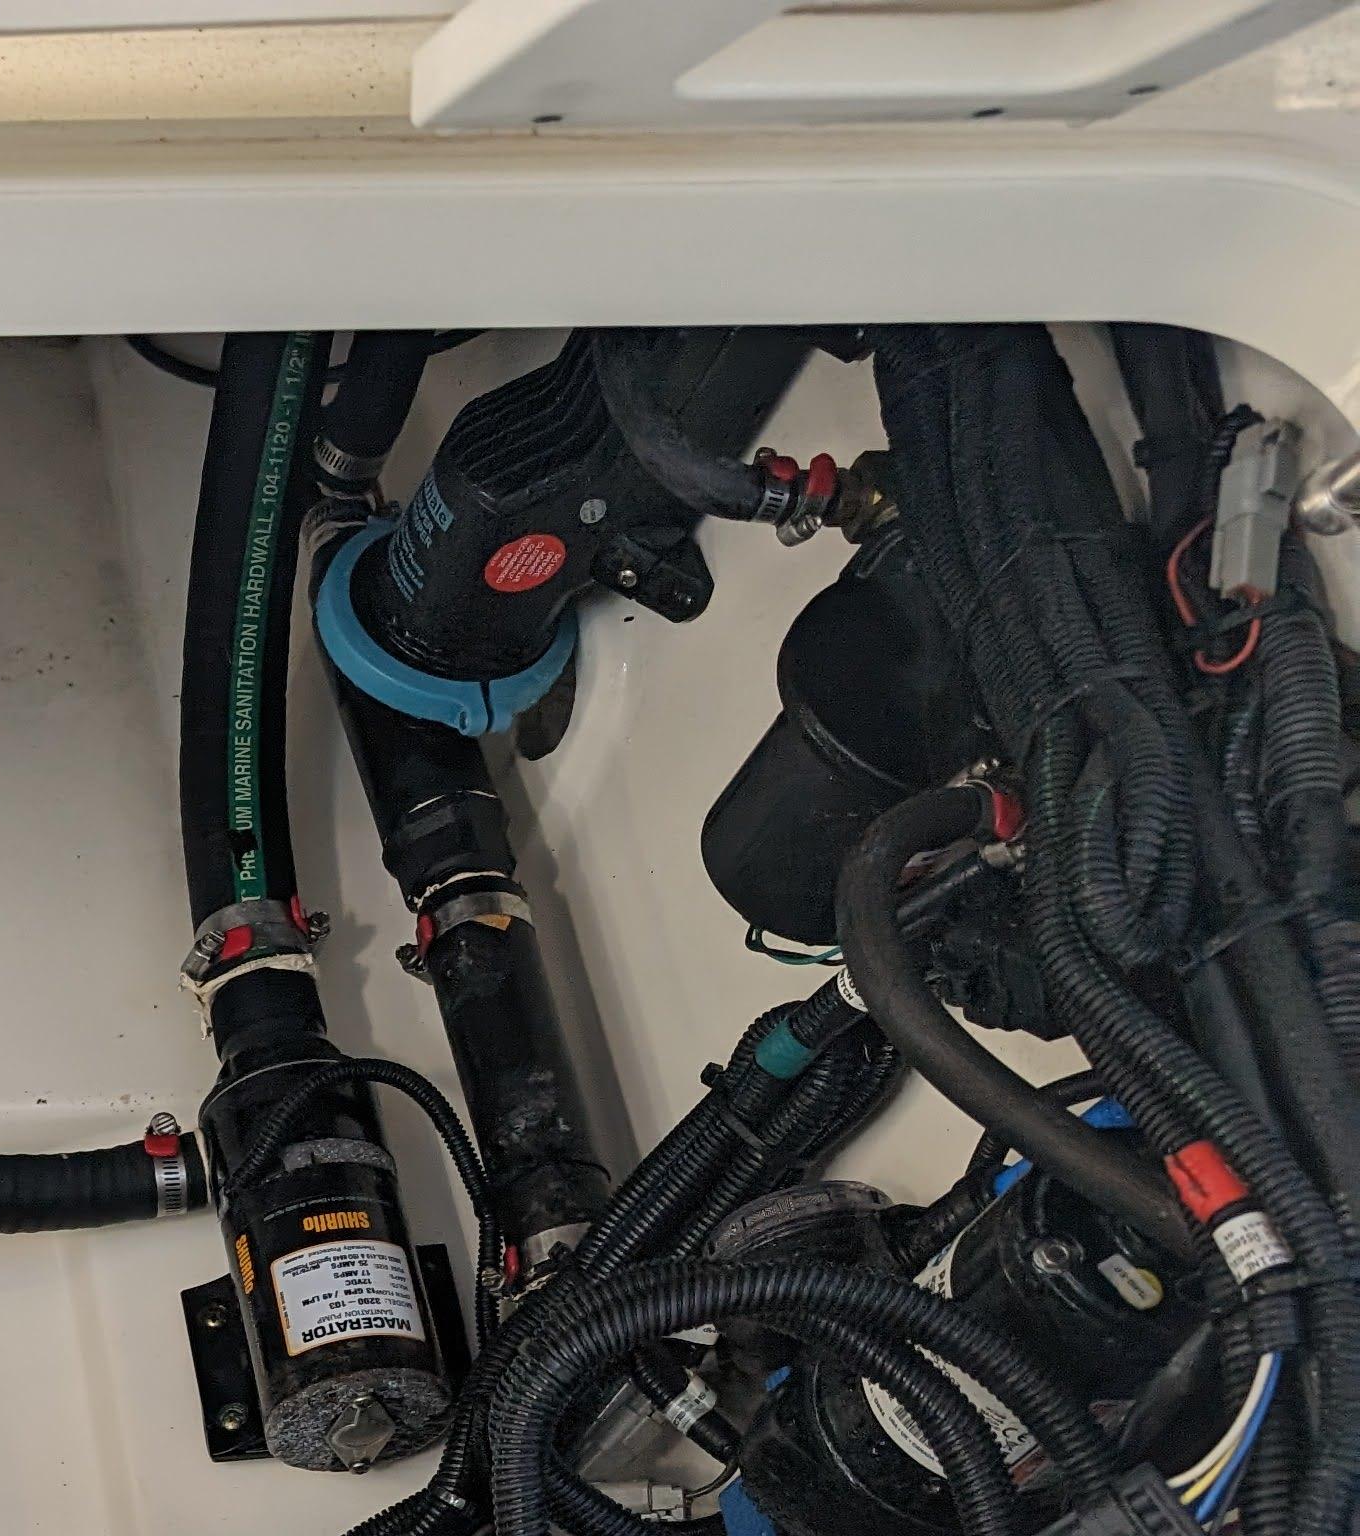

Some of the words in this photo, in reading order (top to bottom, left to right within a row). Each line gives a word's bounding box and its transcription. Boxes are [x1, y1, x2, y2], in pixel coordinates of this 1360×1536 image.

[262, 421, 291, 505] 104-1120
[243, 510, 274, 618] HARDWALL
[235, 623, 259, 731] SANITATION
[234, 736, 251, 798] MARINE
[302, 1211, 370, 1233] SHURflo
[333, 1270, 358, 1280] AMPS
[345, 1278, 373, 1287] 12VDC
[301, 1295, 320, 1306] LPM
[343, 1289, 364, 1297] GPM
[316, 1312, 342, 1324] PUMP
[344, 1308, 394, 1319] SANITATION
[301, 1316, 412, 1344] MACERATOR
